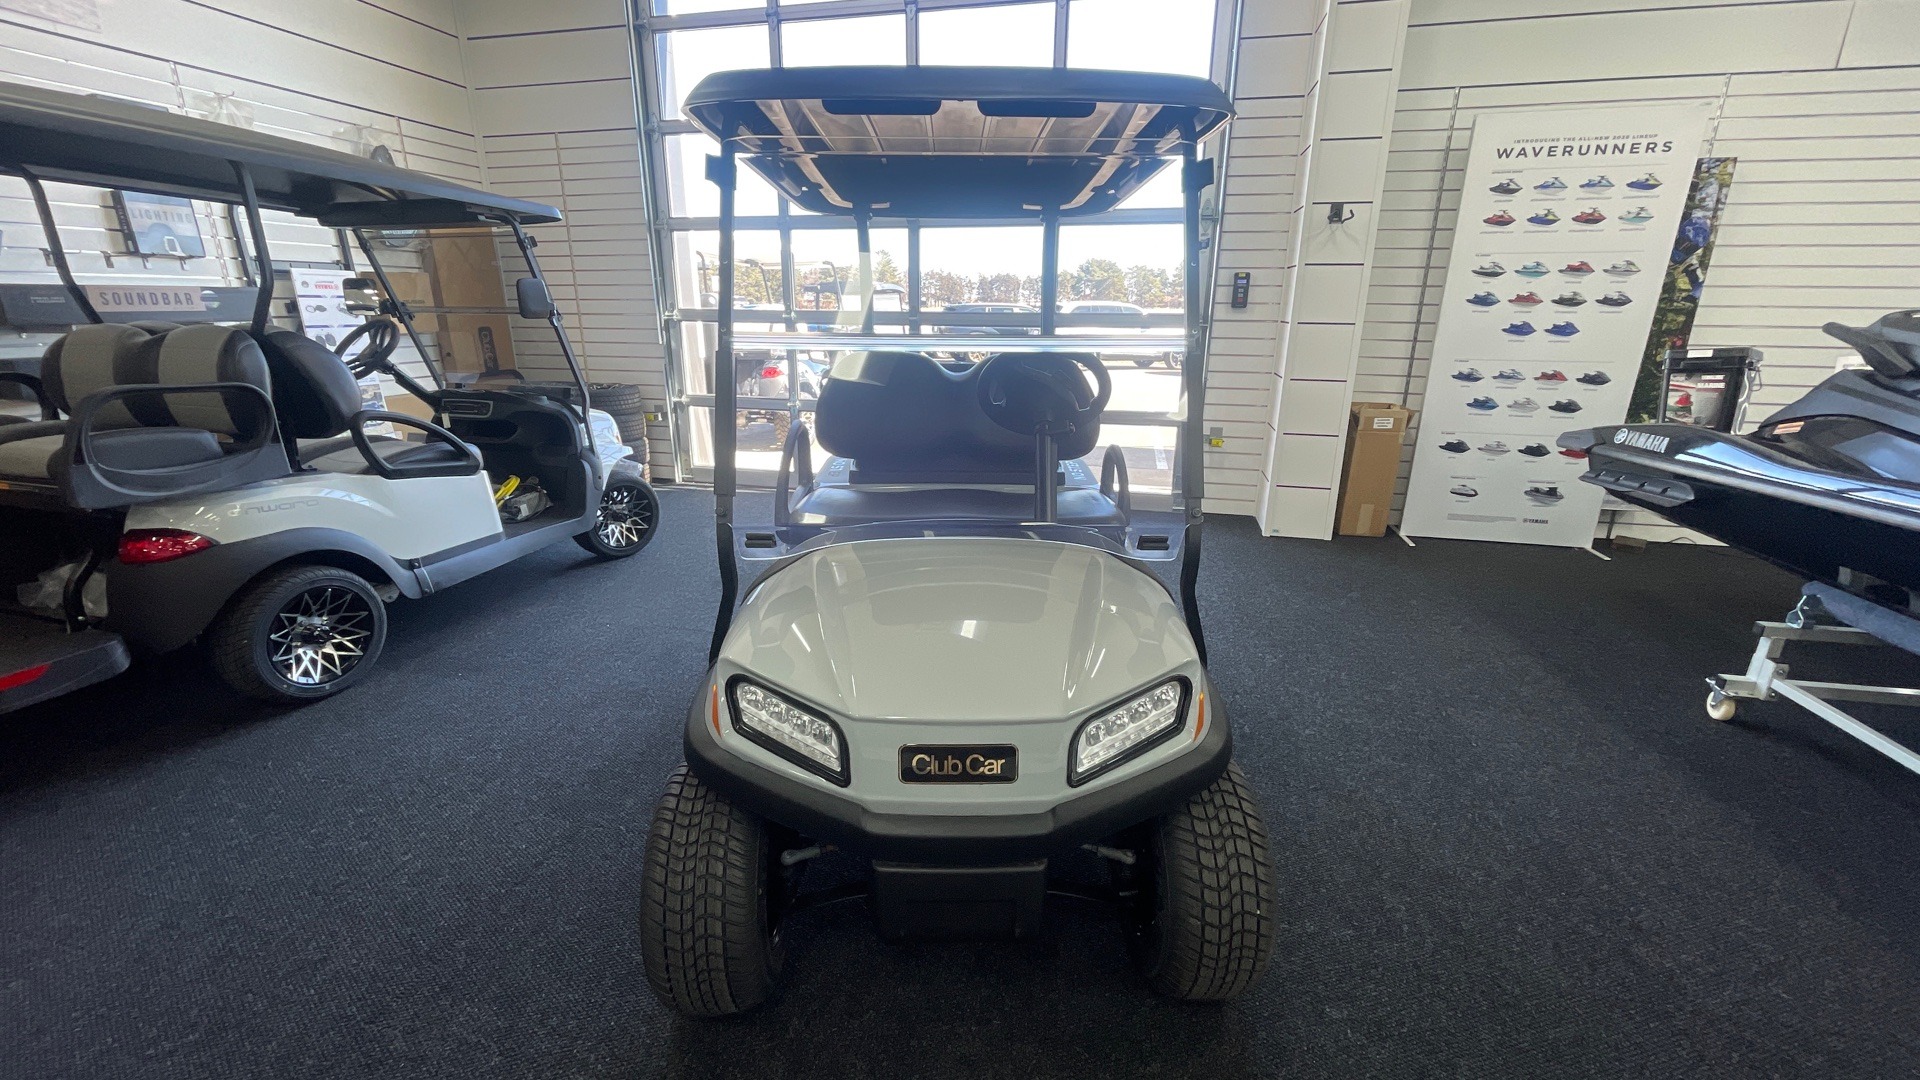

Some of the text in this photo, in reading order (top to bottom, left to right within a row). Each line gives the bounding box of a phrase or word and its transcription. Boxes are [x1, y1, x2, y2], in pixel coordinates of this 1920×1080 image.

[1496, 140, 1673, 159] WAVERUNNERS
[130, 207, 194, 224] LIGHTING
[100, 291, 194, 306] SOUNDBAR
[1625, 430, 1670, 453] YAMAHA
[911, 753, 1006, 775] Club Car
